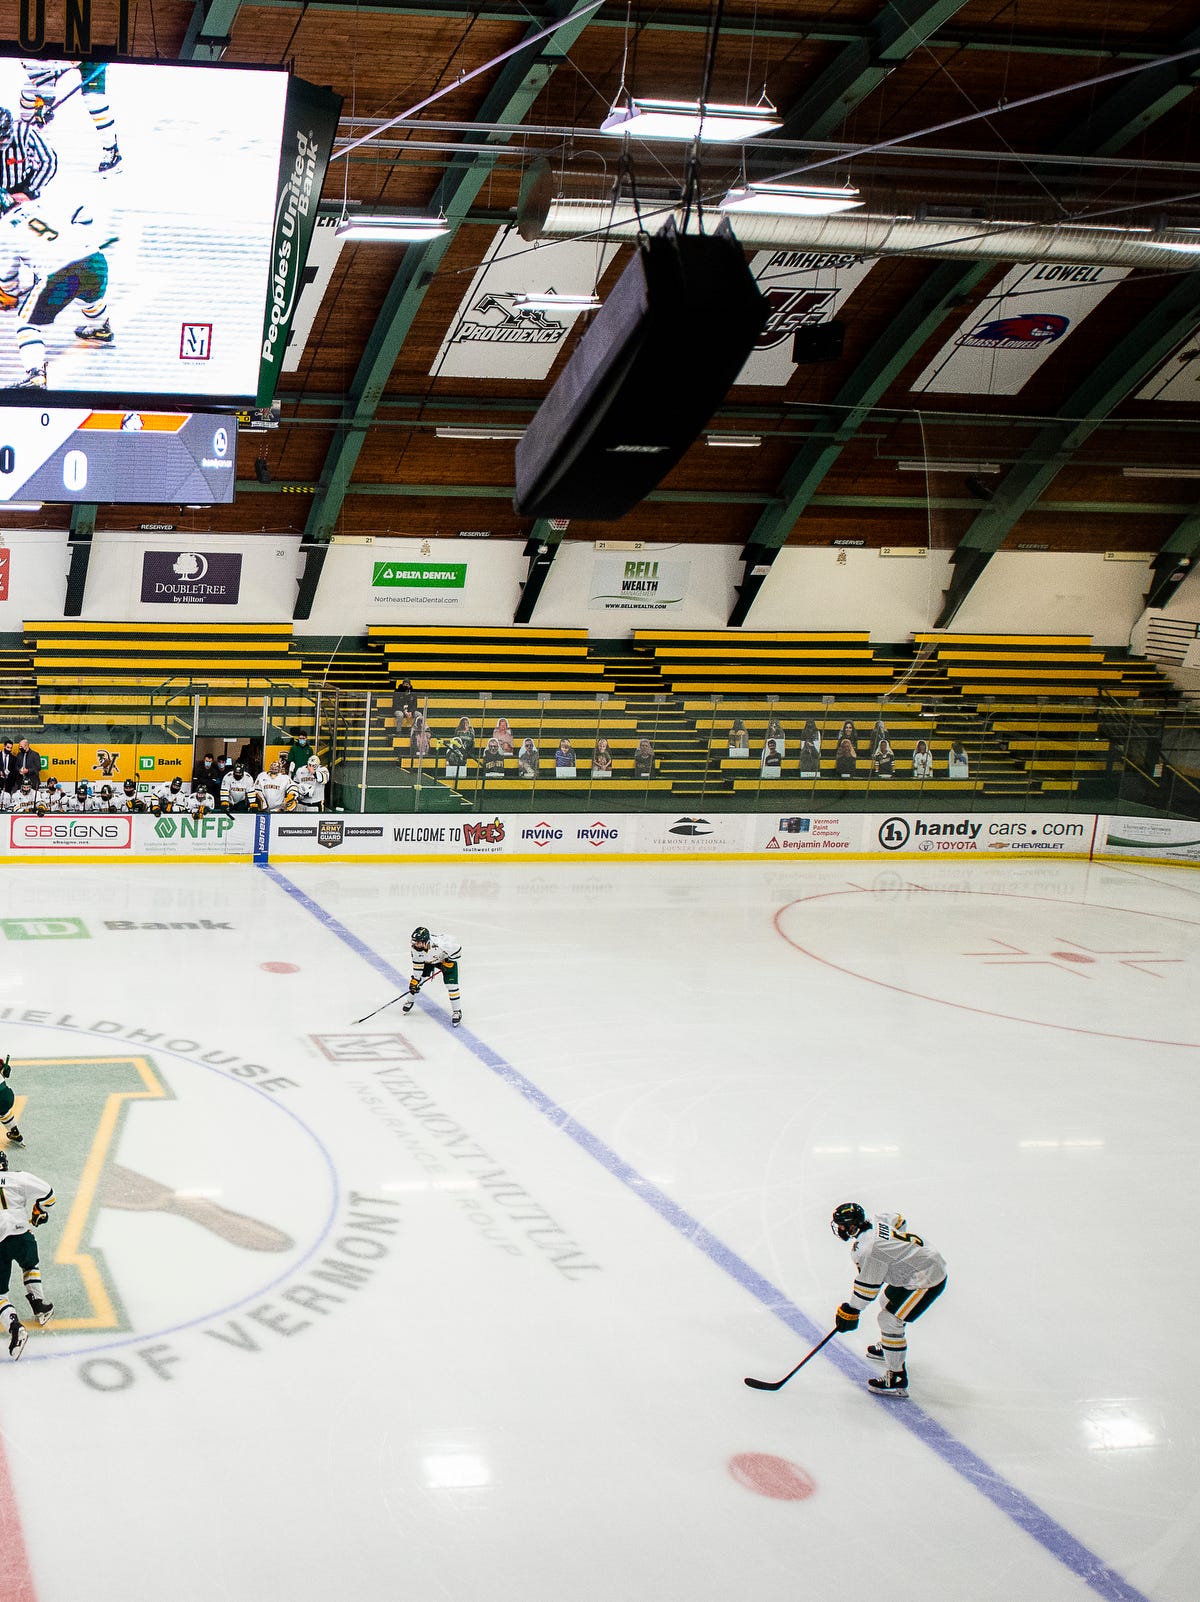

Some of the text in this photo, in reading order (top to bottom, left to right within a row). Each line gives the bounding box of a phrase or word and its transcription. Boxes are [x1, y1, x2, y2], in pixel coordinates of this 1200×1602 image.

[281, 130, 308, 239] United
[298, 143, 318, 217] Bank
[1034, 264, 1104, 282] LOWELL
[453, 320, 568, 343] PROVIDENCE
[40, 413, 50, 426] 0
[64, 450, 88, 491] 0
[396, 571, 456, 580] DELTA DENTAL
[624, 561, 659, 578] BELL
[622, 580, 658, 591] WEALTH
[173, 595, 204, 604] by Hilton
[141, 759, 154, 768] TD
[181, 818, 234, 838] NFP
[394, 828, 461, 842] WELCOME TO
[522, 829, 563, 840] IRVING
[577, 829, 618, 839] IRVING
[915, 819, 982, 837] handy
[783, 839, 850, 850] Benjamin Moore
[936, 841, 977, 850] TOYOTA
[17, 919, 235, 937] TD Bank
[373, 1066, 604, 1282] VERMONT MUTUAL
[77, 1343, 182, 1392] OF
[204, 1190, 402, 1354] VERMONT
